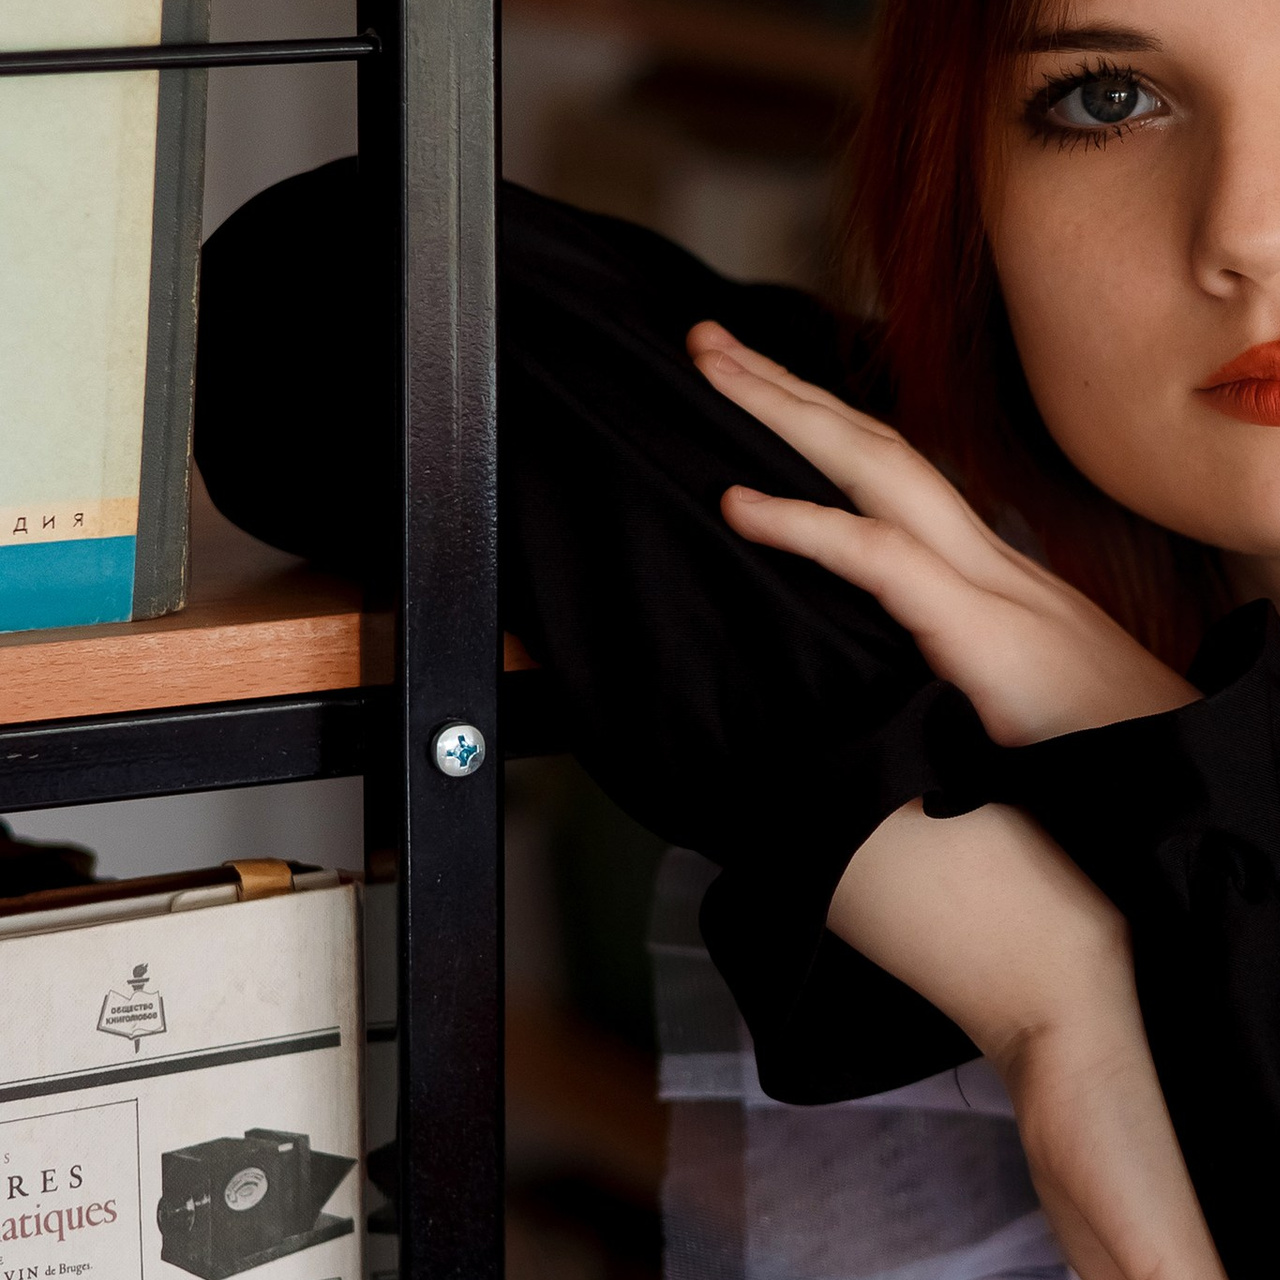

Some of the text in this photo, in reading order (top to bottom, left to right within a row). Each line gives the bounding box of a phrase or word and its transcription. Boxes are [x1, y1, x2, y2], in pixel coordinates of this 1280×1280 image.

[12, 512, 84, 535] ДИЯ
[111, 1003, 153, 1014] ОБЩЕСТВО
[105, 1012, 157, 1025] КНИГОЛЮБОВ
[7, 1164, 83, 1200] RES
[45, 1265, 56, 1276] de
[59, 1262, 93, 1275] Bruges.
